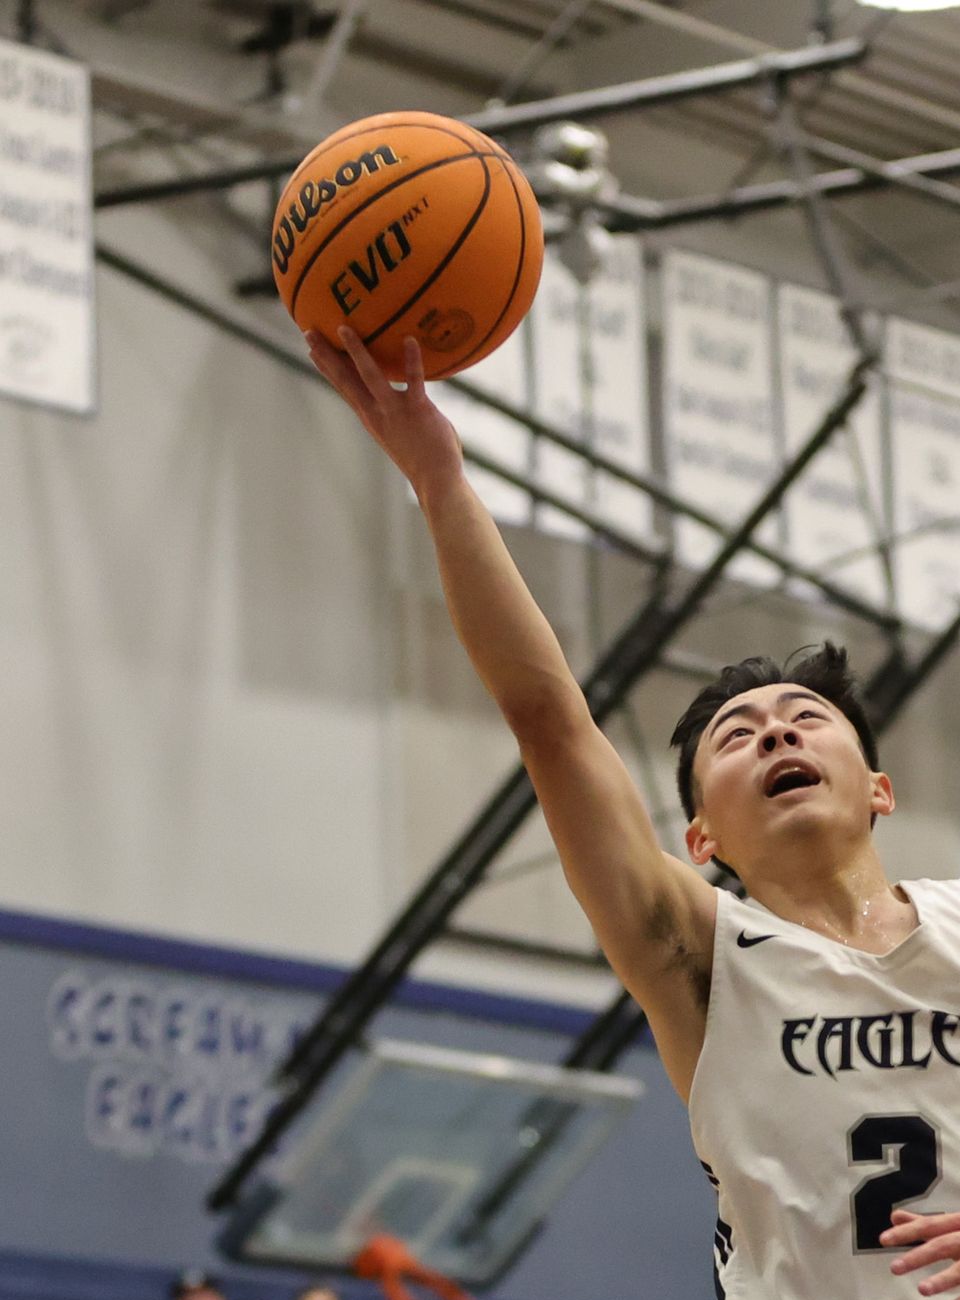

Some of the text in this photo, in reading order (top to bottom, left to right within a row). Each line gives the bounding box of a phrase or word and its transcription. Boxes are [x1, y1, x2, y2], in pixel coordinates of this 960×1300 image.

[272, 144, 402, 274] Wilson
[330, 220, 413, 317] EVO
[846, 1111, 946, 1257] 2
